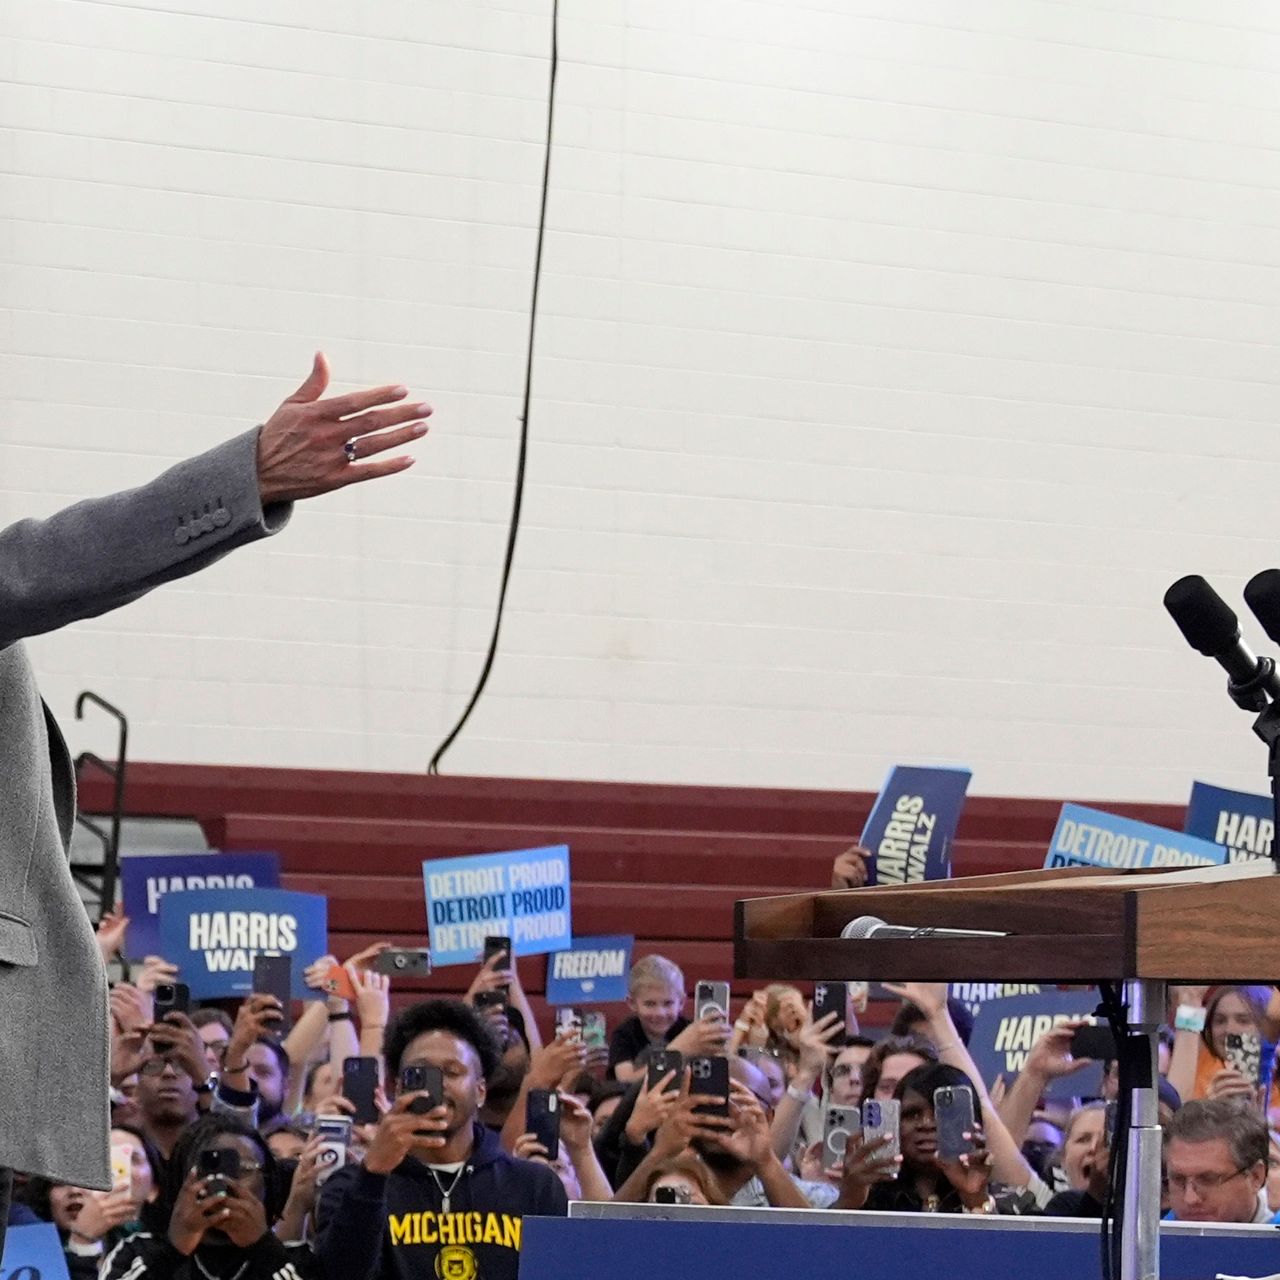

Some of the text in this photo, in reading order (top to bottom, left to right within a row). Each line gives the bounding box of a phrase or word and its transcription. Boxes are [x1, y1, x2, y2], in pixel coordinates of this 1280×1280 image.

[1056, 819, 1150, 868] DETROIT
[1215, 810, 1276, 857] HAR
[429, 858, 567, 900] DETROIT PROUD
[432, 886, 566, 926] DETROIT PROUD
[189, 911, 299, 951] HARRIS
[513, 912, 567, 944] PROUD
[553, 949, 625, 980] FREEDOM
[388, 1210, 522, 1252] MICHIGAN
